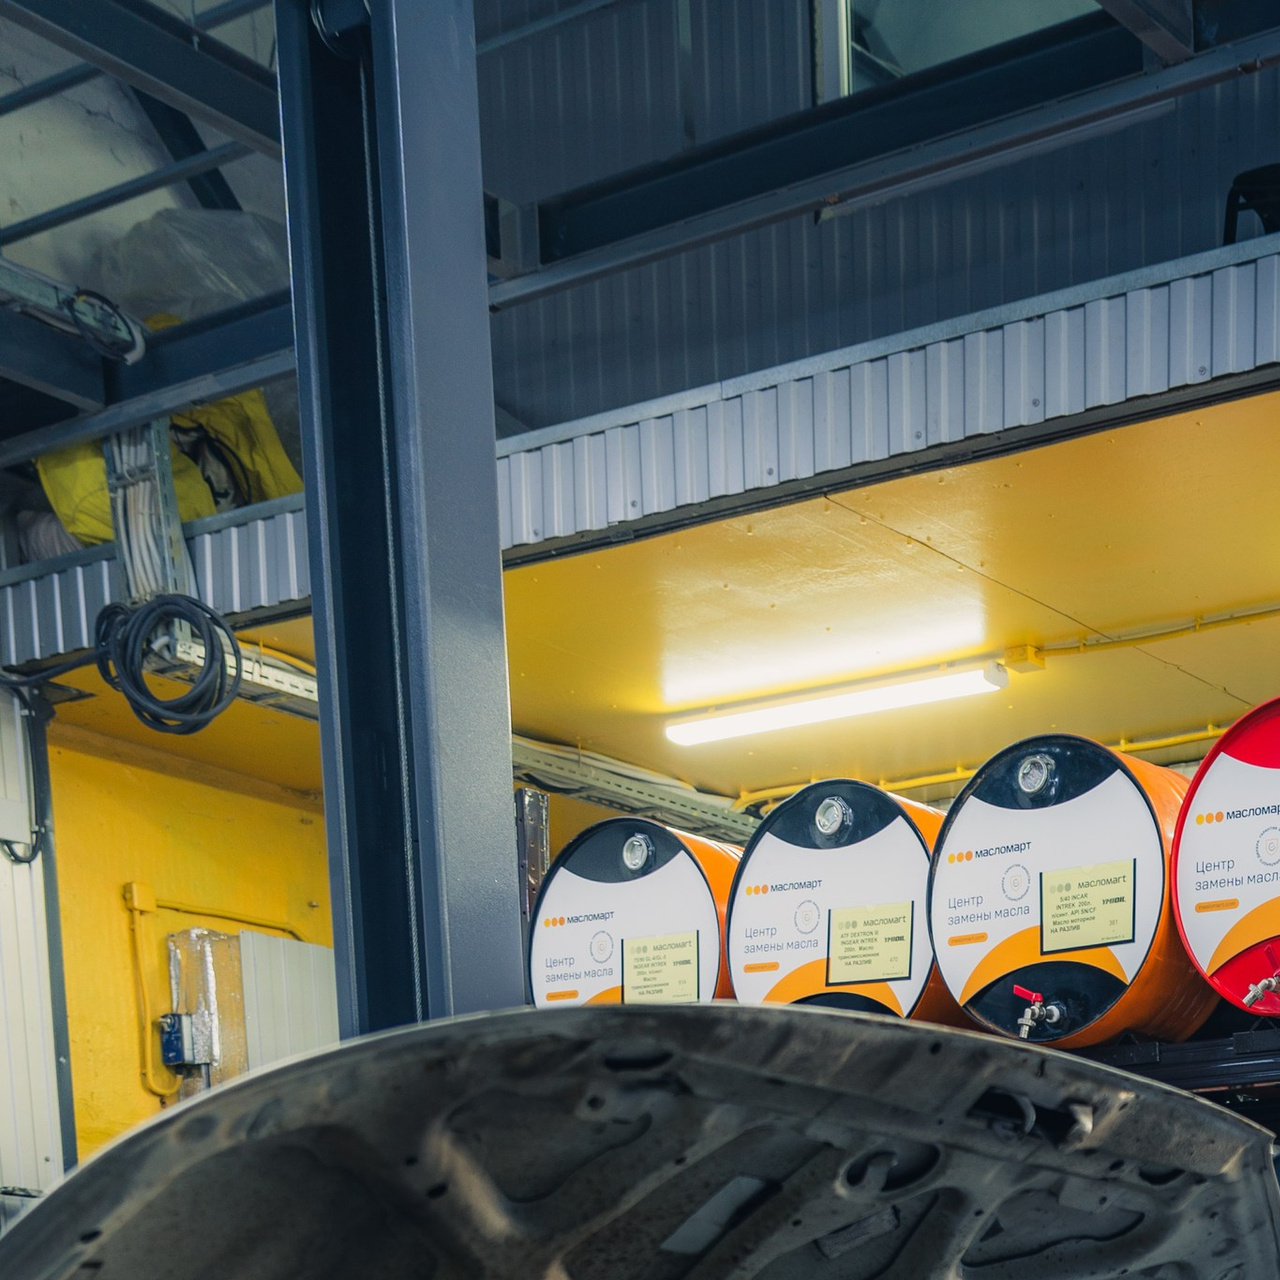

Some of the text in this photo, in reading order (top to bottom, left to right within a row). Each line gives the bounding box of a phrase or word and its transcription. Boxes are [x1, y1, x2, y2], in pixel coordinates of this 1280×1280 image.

[975, 841, 1032, 859] масломарт
[1196, 858, 1235, 873] Центр
[770, 879, 822, 892] масломарт
[1195, 876, 1244, 891] замены
[948, 895, 984, 910] Центр
[567, 911, 615, 924] масломарт
[948, 905, 1030, 926] замены масла
[745, 927, 777, 939] Центр
[744, 939, 819, 954] замены масла
[545, 956, 575, 968] Центр
[545, 968, 613, 983] замены масла
